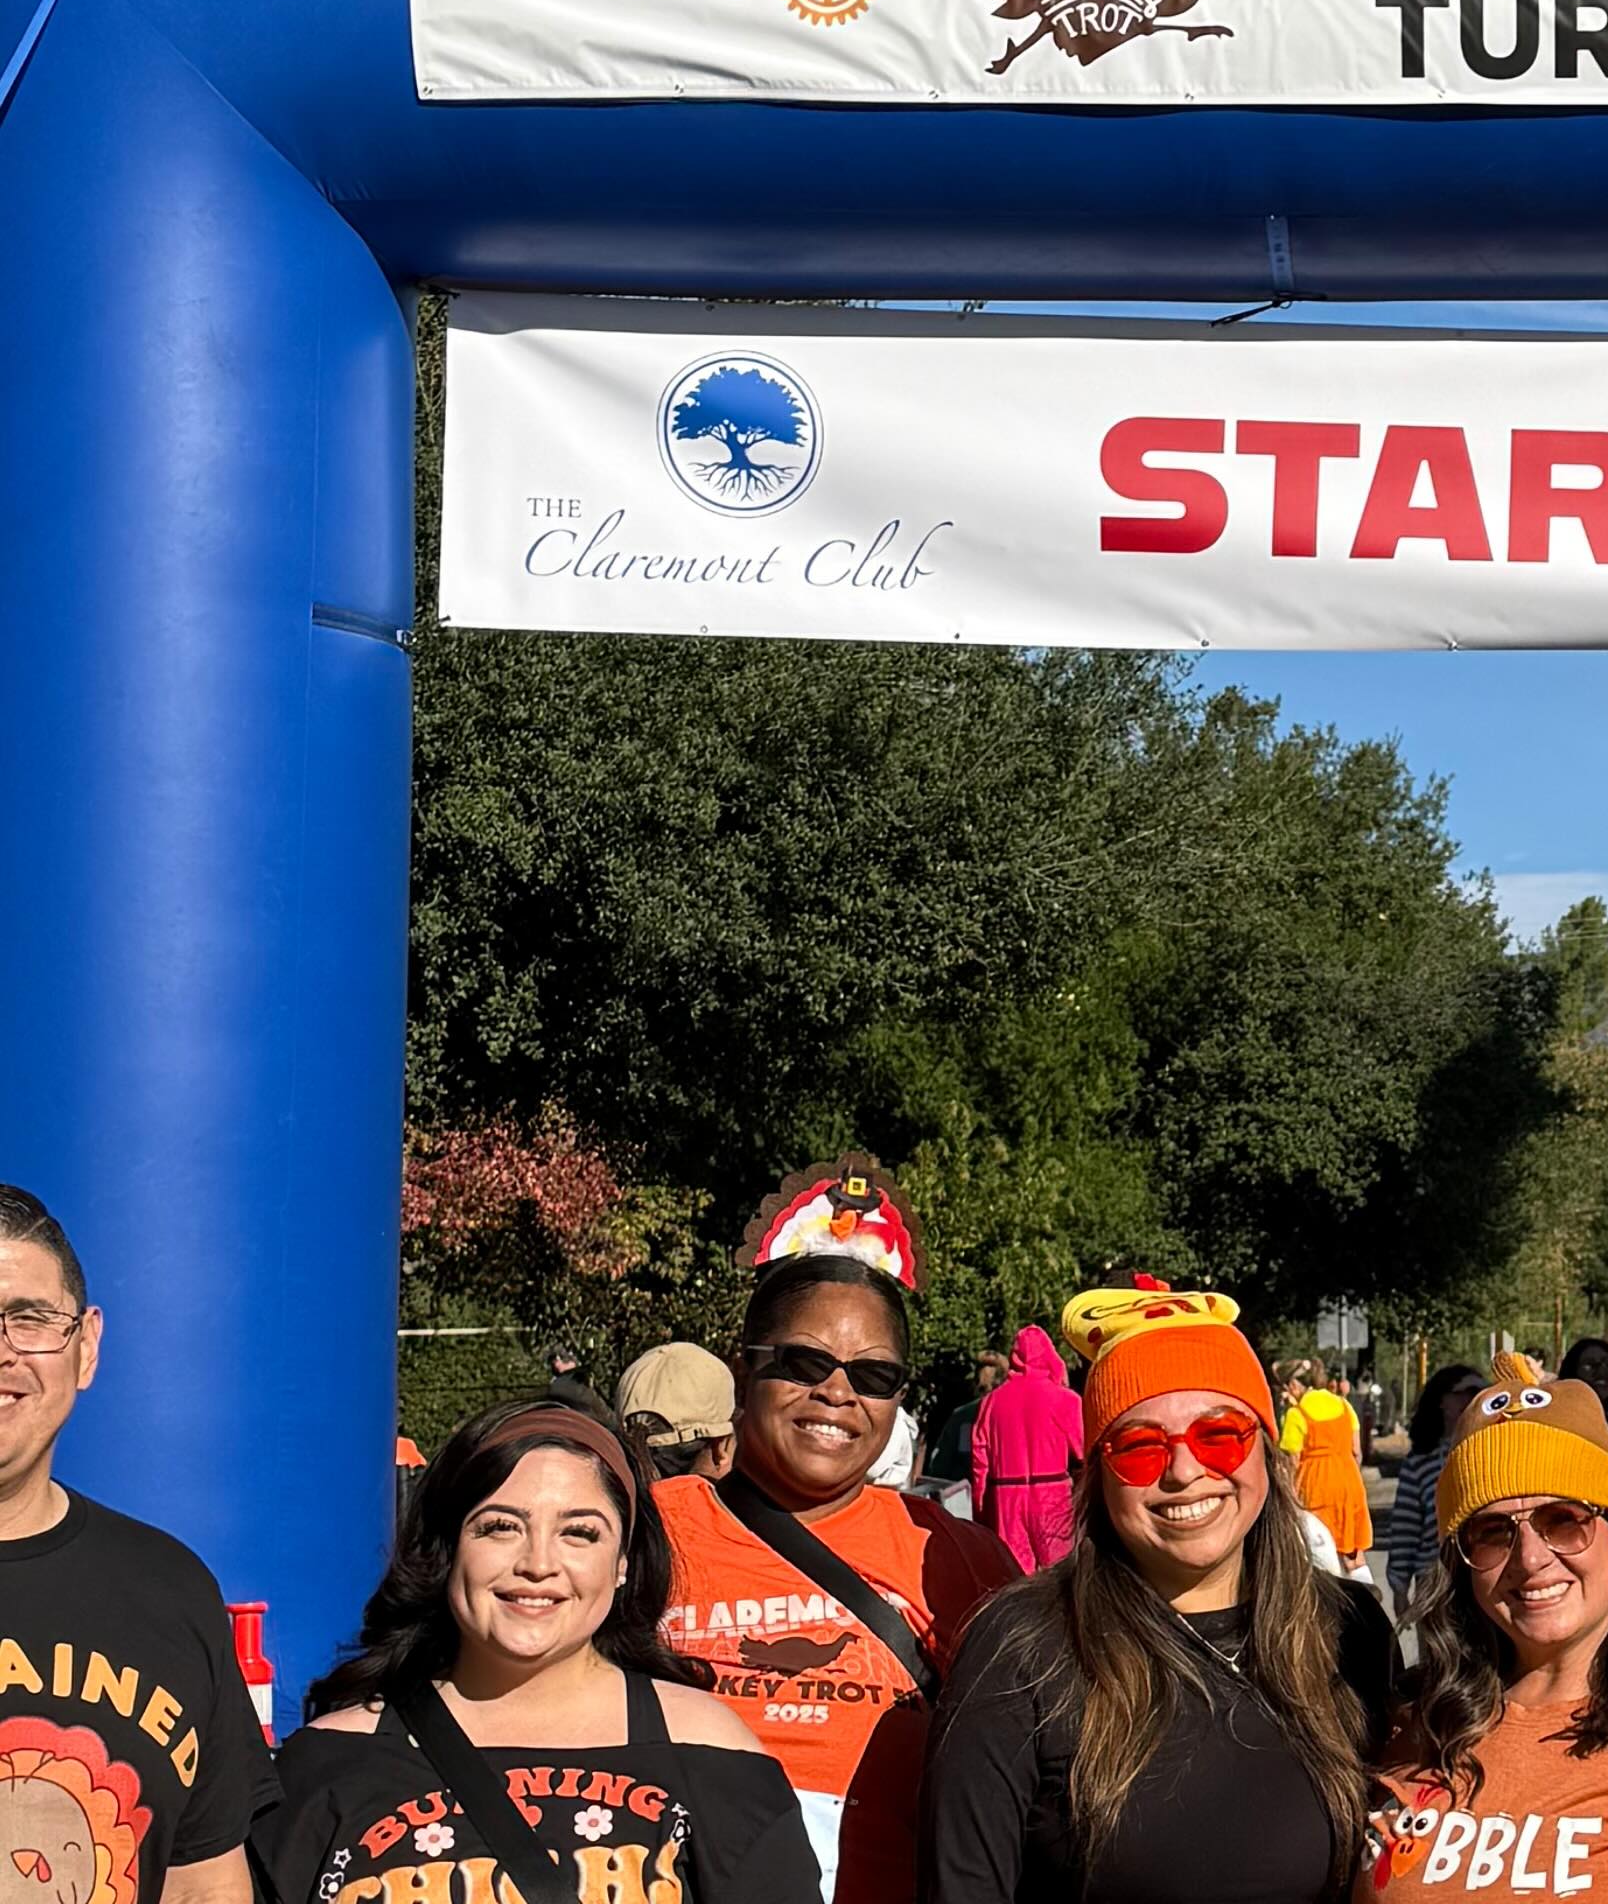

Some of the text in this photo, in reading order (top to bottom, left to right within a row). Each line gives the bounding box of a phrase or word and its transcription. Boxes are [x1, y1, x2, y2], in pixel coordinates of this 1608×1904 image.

[1052, 3, 1143, 38] TROT
[527, 497, 581, 518] THE
[525, 509, 954, 591] Claremont Club
[656, 1593, 858, 1641] CLAREMO
[711, 1674, 785, 1698] KEY
[797, 1681, 884, 1704] TROT
[764, 1703, 829, 1724] 2025
[359, 1767, 669, 1859] BUNING
[1370, 1807, 1602, 1898] BBLE
